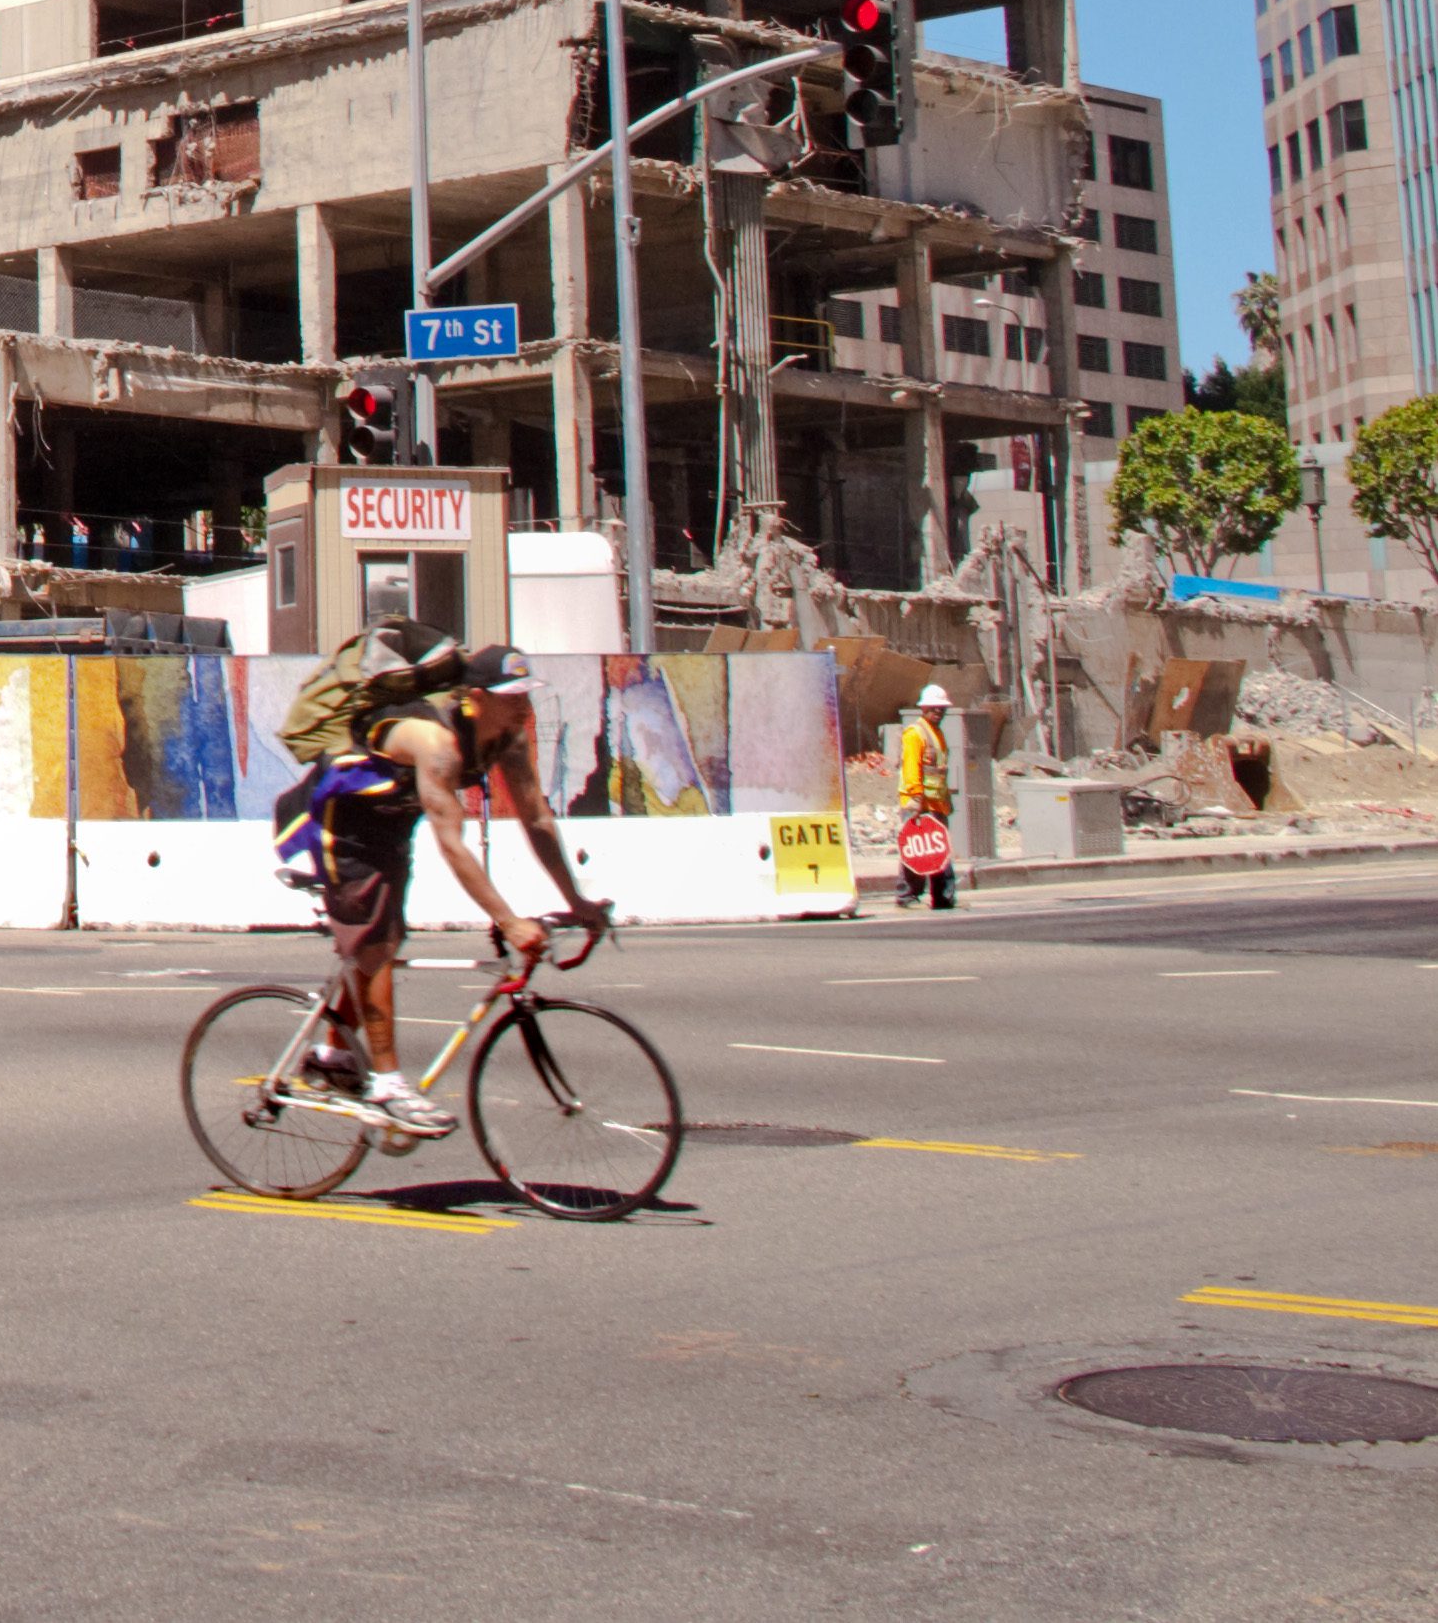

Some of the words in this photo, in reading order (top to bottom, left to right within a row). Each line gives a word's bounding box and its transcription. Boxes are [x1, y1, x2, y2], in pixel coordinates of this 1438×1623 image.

[420, 318, 464, 351] 7th
[473, 319, 503, 346] St
[346, 486, 464, 530] SECURITY
[779, 823, 841, 846] GATE
[902, 830, 946, 859] STOP
[807, 863, 819, 884] 7
